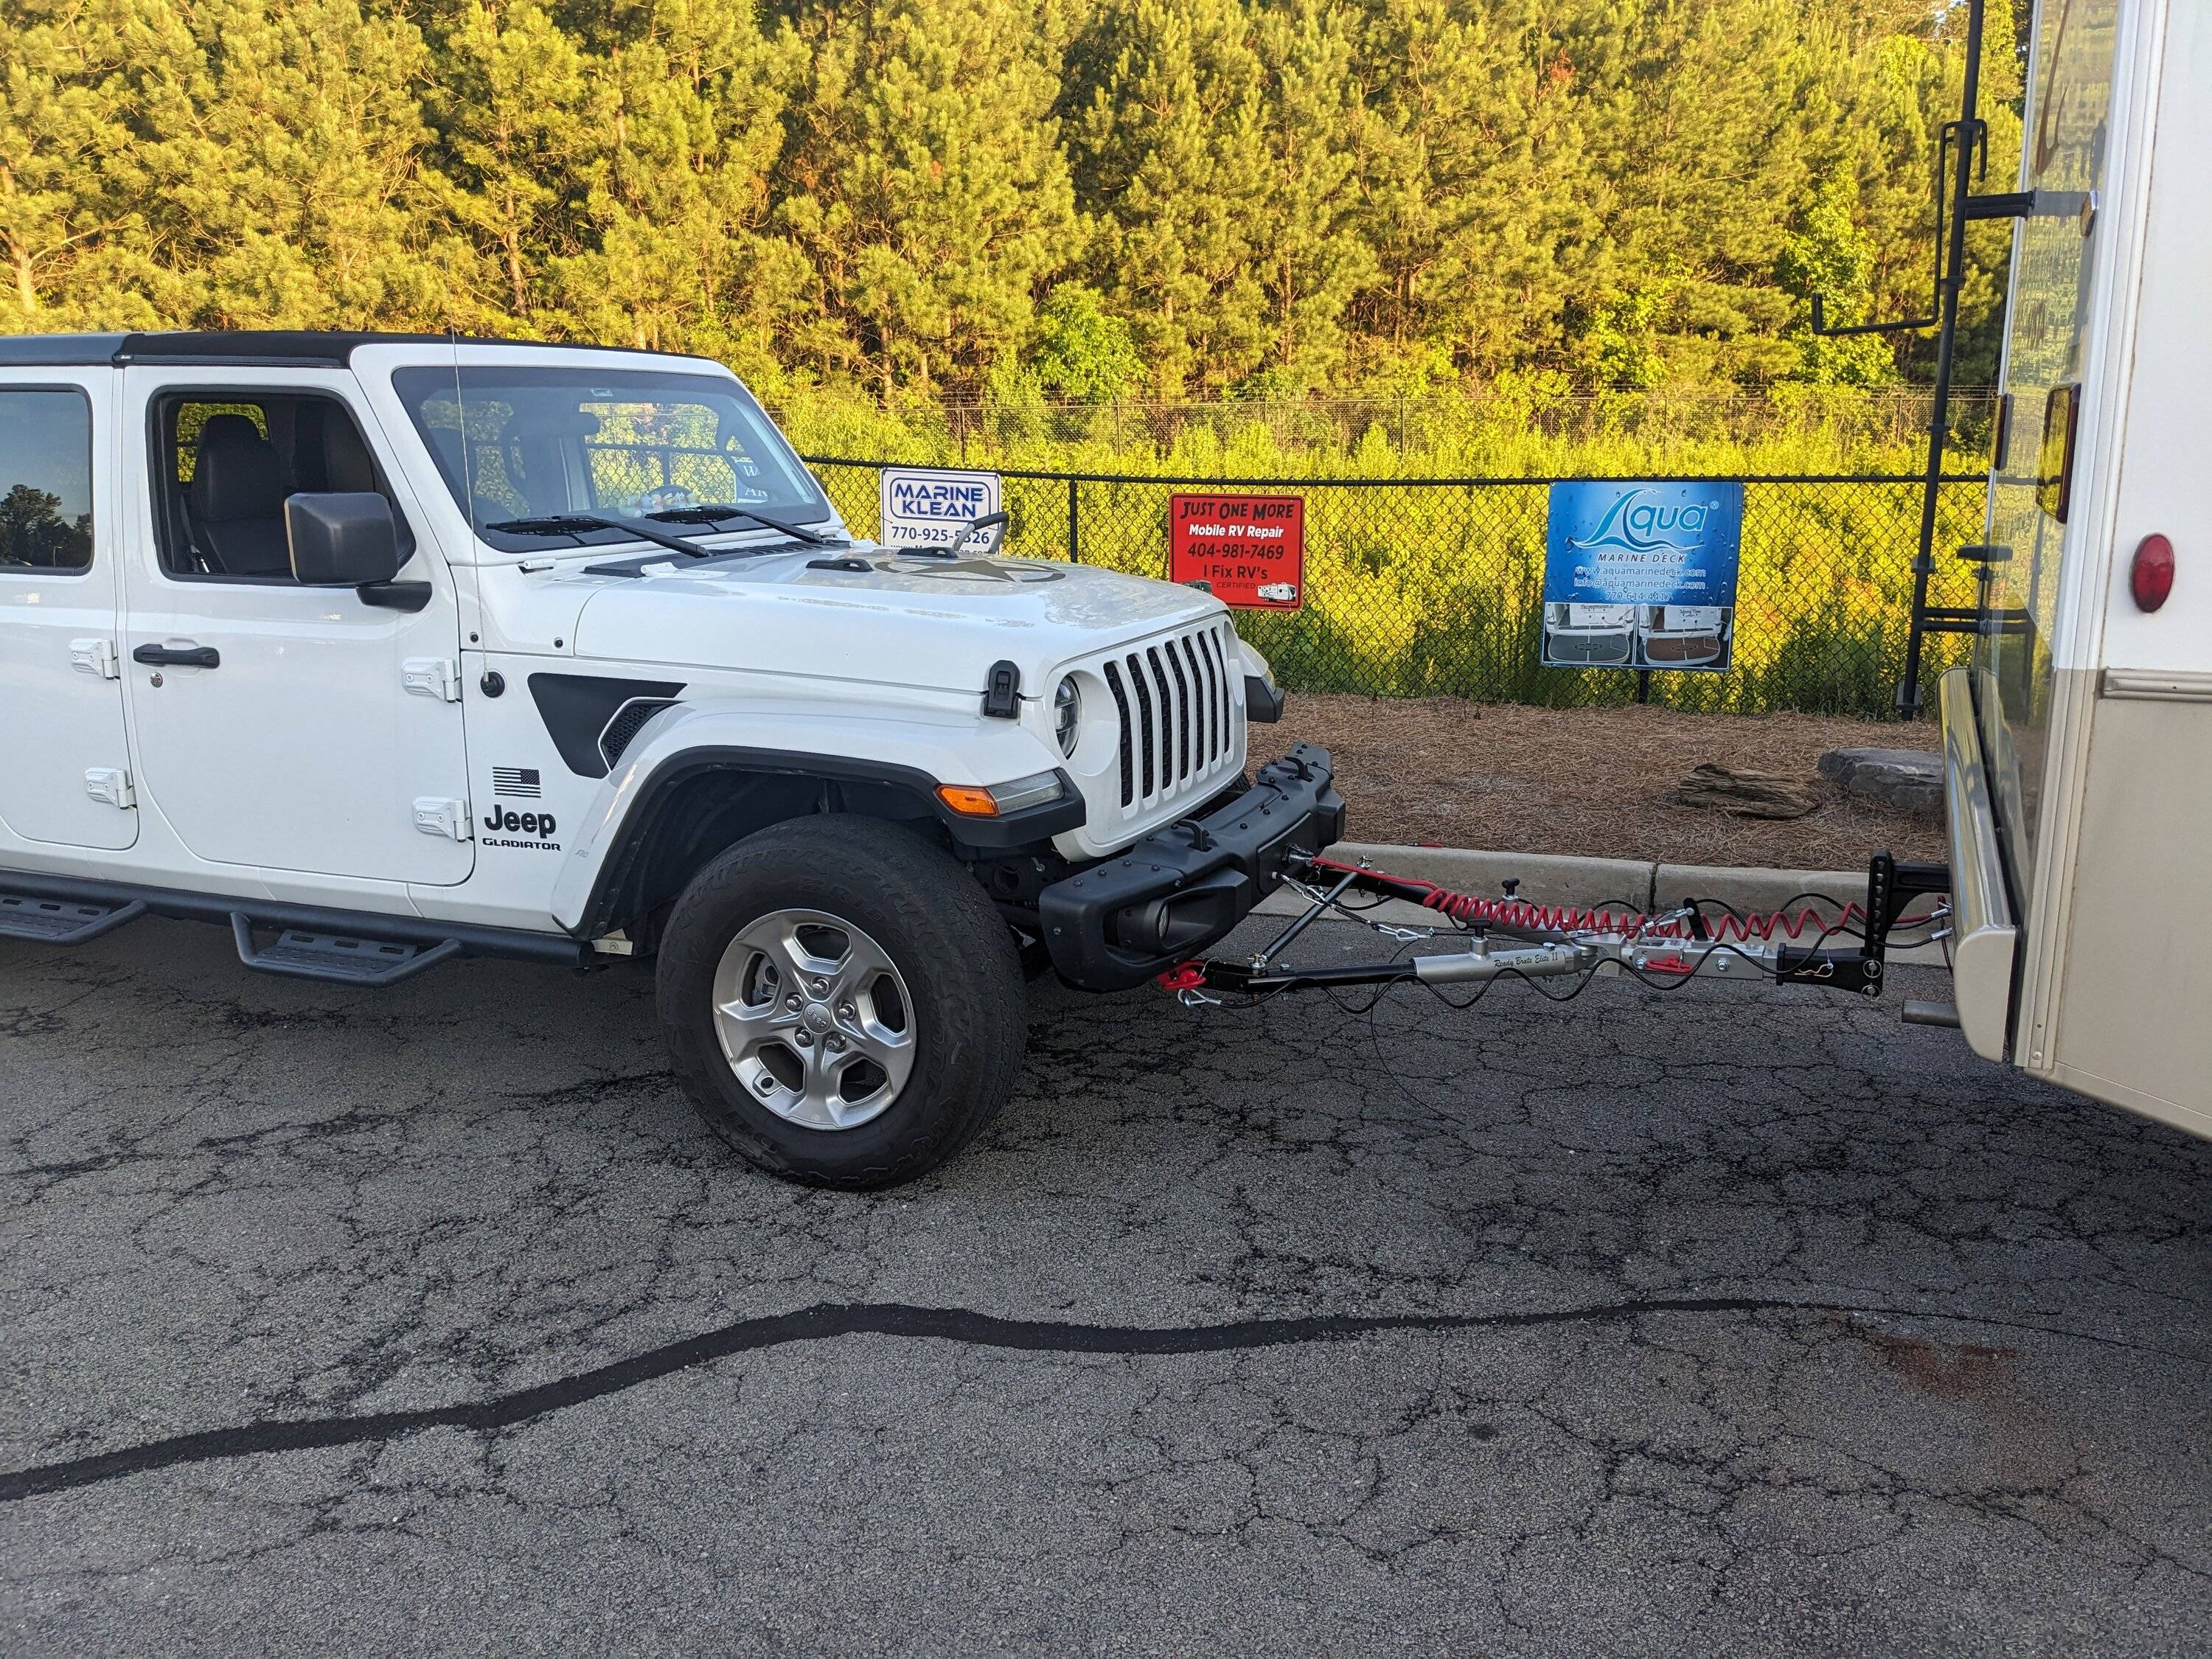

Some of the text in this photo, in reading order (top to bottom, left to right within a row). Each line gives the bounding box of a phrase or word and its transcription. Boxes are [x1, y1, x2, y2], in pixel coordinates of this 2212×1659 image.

[894, 484, 984, 502] MARINE
[902, 500, 976, 518] KLEAN
[1180, 501, 1293, 521] JUST ONE MORE
[1571, 487, 1708, 552] Aqua
[1189, 524, 1284, 539] Mobile RV Repair
[1188, 543, 1284, 560] 404-981-7469
[1597, 554, 1686, 563] MARINE DECK
[1203, 565, 1268, 580] I Fix RV's
[1575, 566, 1706, 577] www.aquamarinedeck.com
[1574, 578, 1705, 590] info@aquamarinedeck.com
[1605, 591, 1672, 602] 770-614-4417
[484, 804, 556, 838] Jeep
[482, 838, 561, 851] GLADIATOR
[1494, 952, 1557, 968] Ready Brute Elite II
[807, 1006, 827, 1027] Jeep
